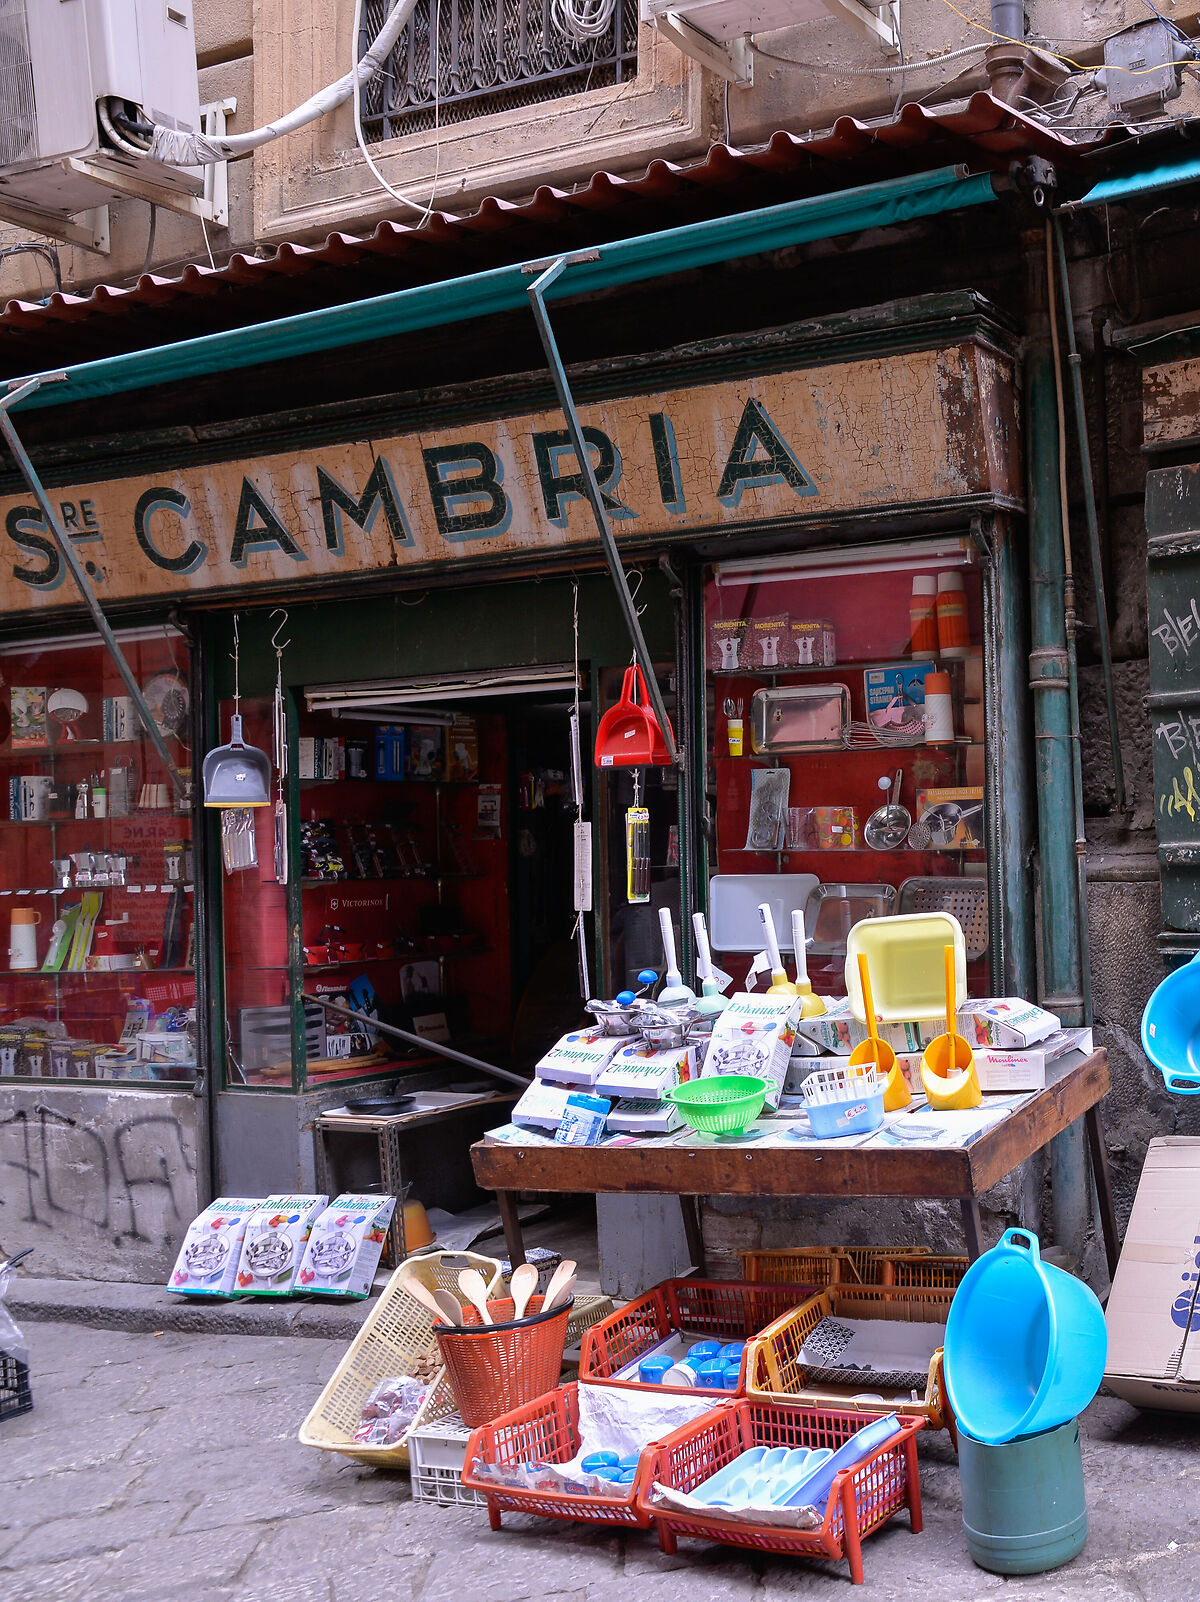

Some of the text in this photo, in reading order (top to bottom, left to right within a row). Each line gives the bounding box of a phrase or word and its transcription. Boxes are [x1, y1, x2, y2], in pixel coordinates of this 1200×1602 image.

[134, 397, 820, 577] CAMBRIA
[342, 898, 384, 908] VICTORINOX
[986, 1054, 1029, 1064] Moulinex
